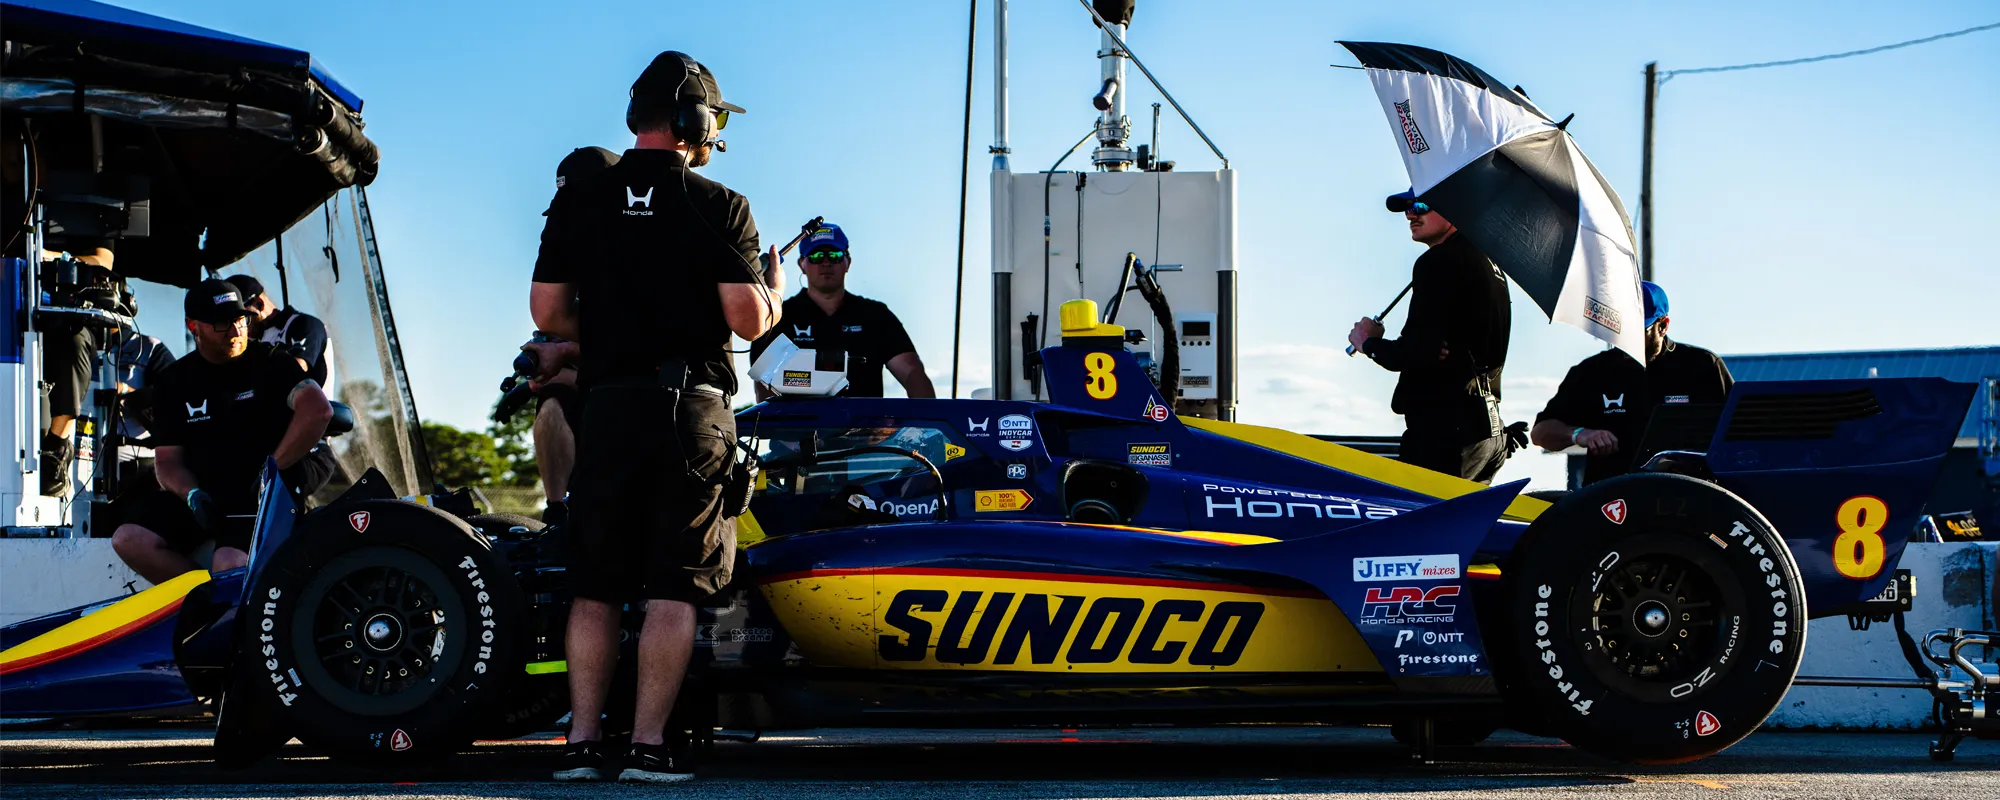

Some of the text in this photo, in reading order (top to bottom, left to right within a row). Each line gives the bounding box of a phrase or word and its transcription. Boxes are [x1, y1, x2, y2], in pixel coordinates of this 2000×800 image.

[1585, 308, 1620, 330] RACING
[1084, 352, 1118, 400] 8
[1154, 407, 1164, 419] E
[1008, 466, 1025, 477] PPG
[1203, 483, 1360, 503] Powered by
[1205, 496, 1398, 520] Honda
[1832, 495, 1890, 580] 8
[1422, 565, 1456, 576] mixes
[1729, 520, 1787, 654] Firestone
[458, 555, 497, 674] Firestone
[1360, 585, 1461, 618] HRC
[878, 589, 1266, 667] SUNOCO
[1438, 632, 1464, 642] NTT
[1720, 615, 1740, 664] RACING
[260, 586, 298, 706] Firestone
[1398, 653, 1479, 667] Firestone
[1535, 584, 1594, 716] Firestone
